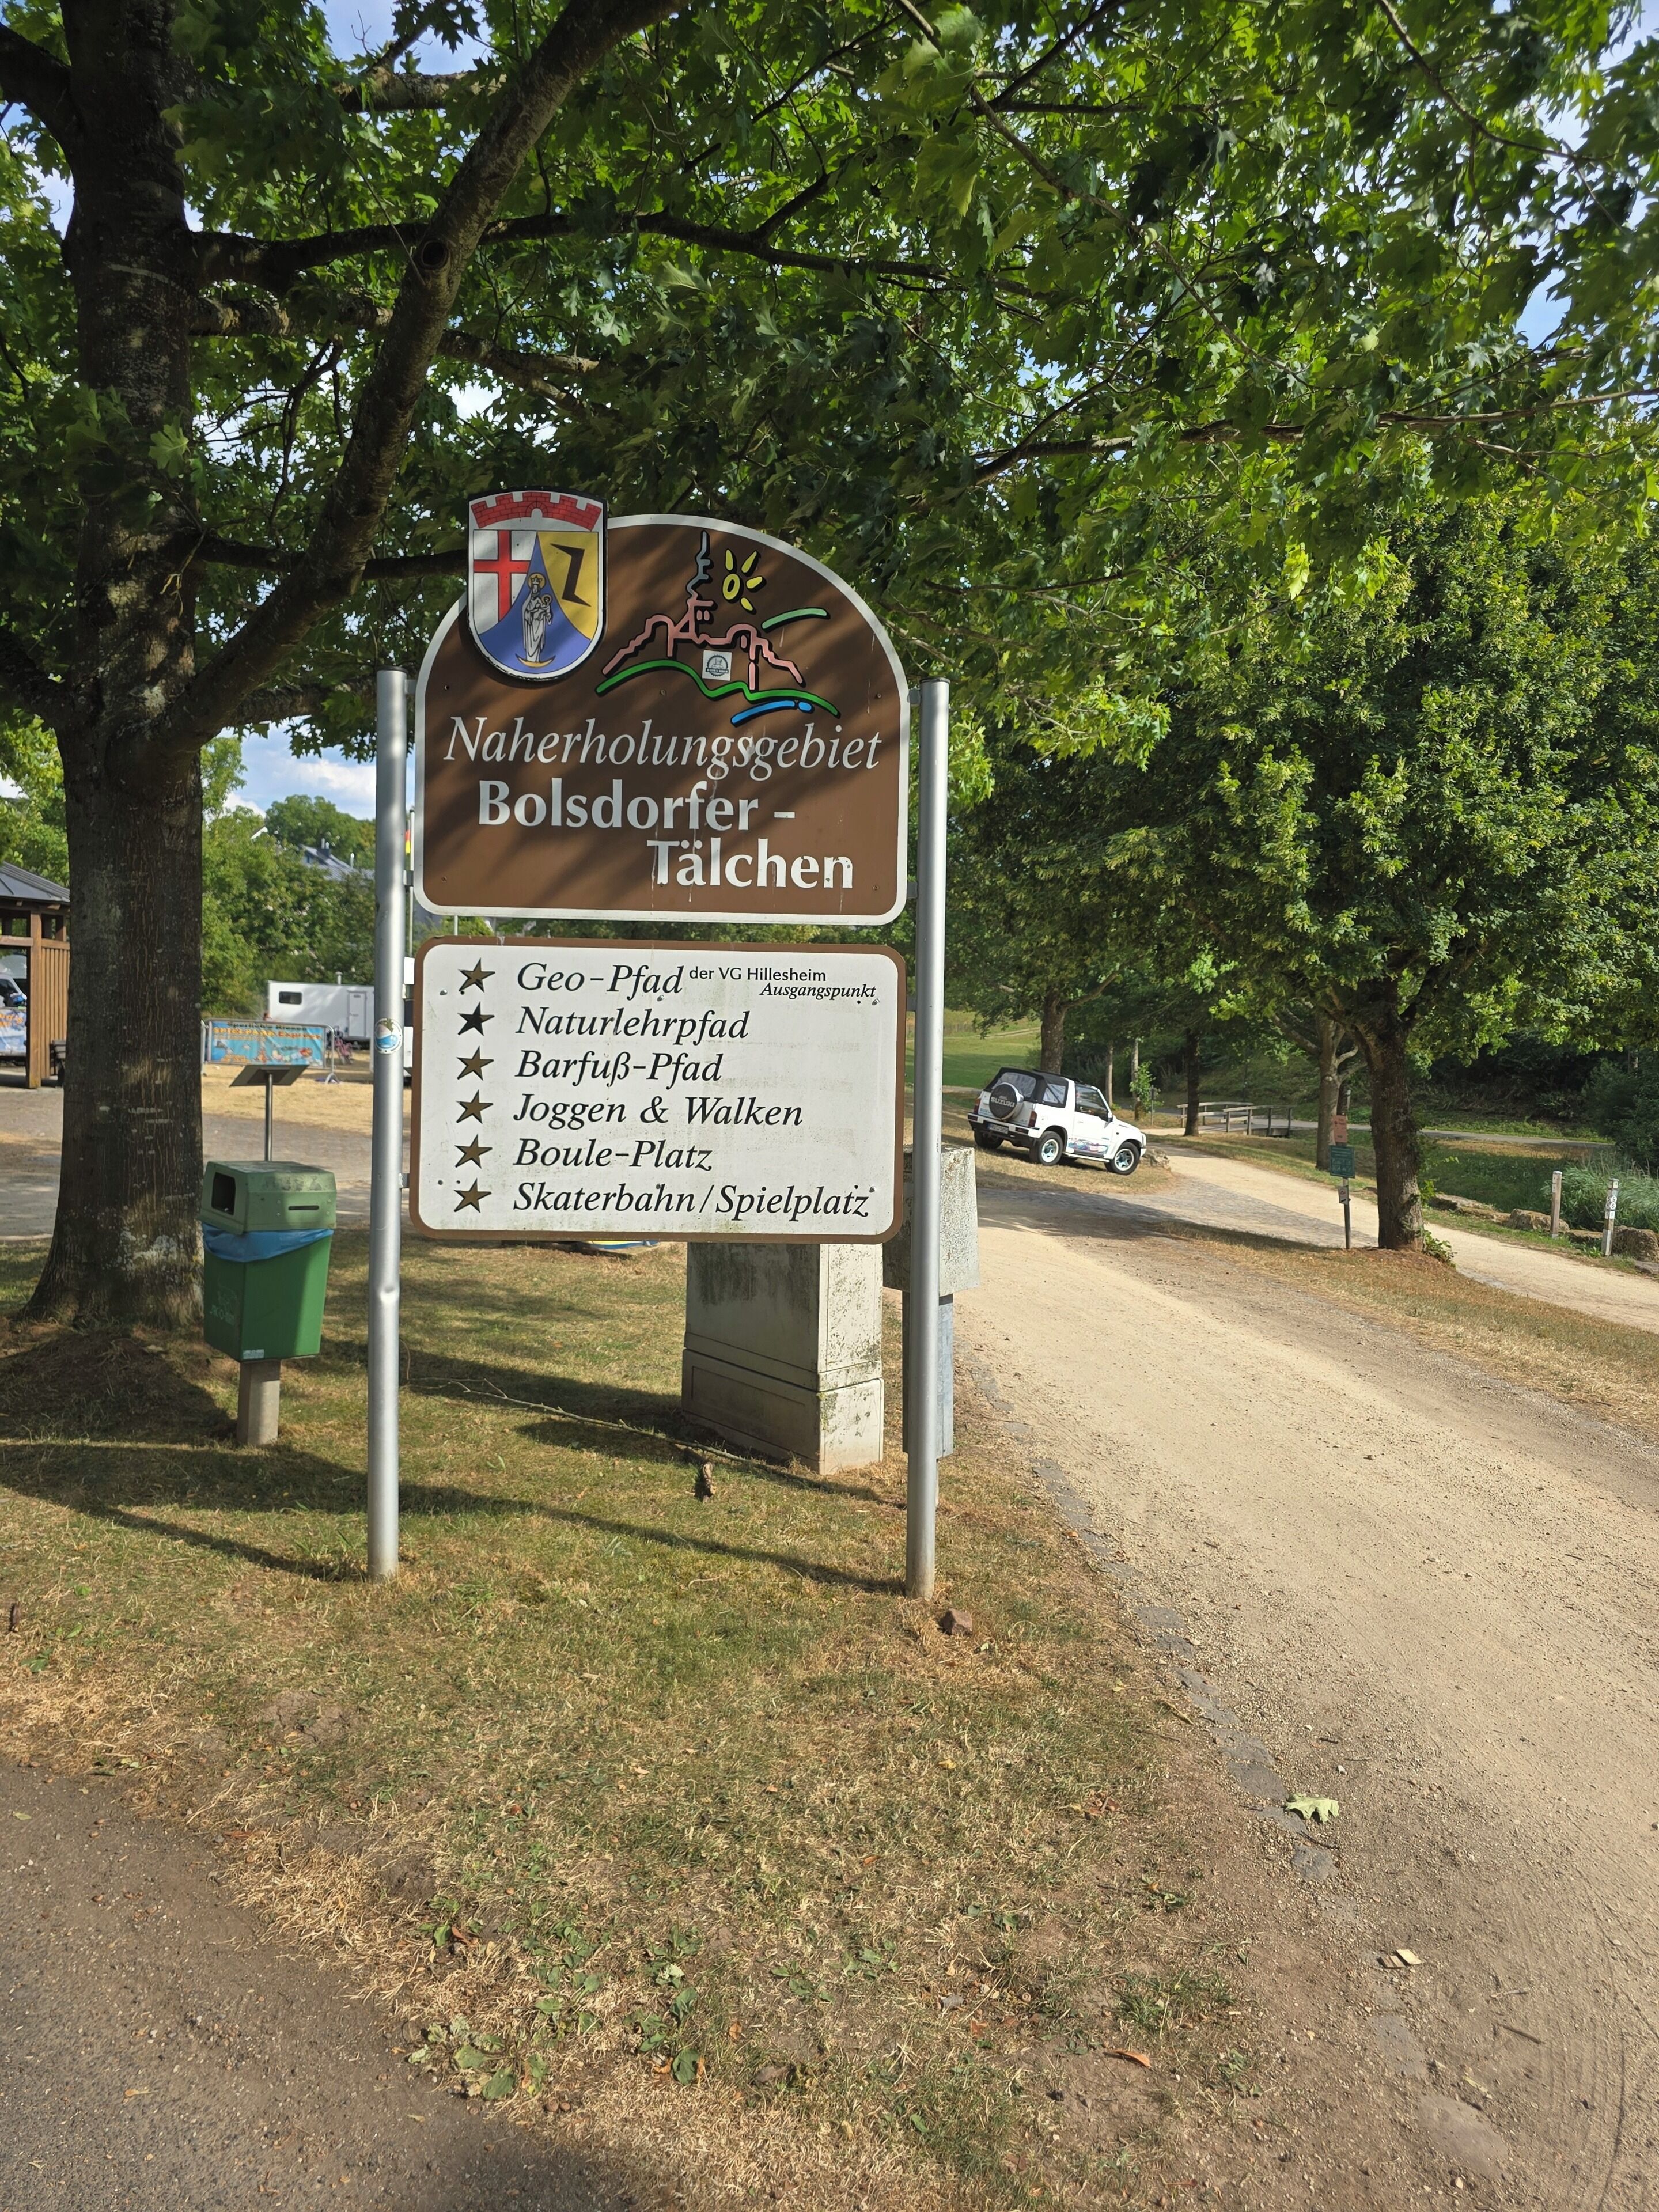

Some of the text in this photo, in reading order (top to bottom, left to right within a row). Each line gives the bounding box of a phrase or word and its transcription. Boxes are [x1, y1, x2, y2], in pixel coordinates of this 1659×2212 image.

[443, 717, 882, 781] Naherholungsgebiet
[479, 778, 759, 831] Bolsdorfer
[647, 836, 853, 889] Tälchen
[517, 963, 826, 1001] Geo-Pfad der VG Hillesheim
[759, 982, 876, 1001] Ausgangspunkt
[516, 1006, 750, 1046] Naturlehrpfad
[514, 1050, 724, 1090] Barfuß-Pfad
[513, 1093, 803, 1130] Joggen & Walken
[991, 1096, 1015, 1108] SUZUKI
[513, 1138, 713, 1171] Boule-Platz
